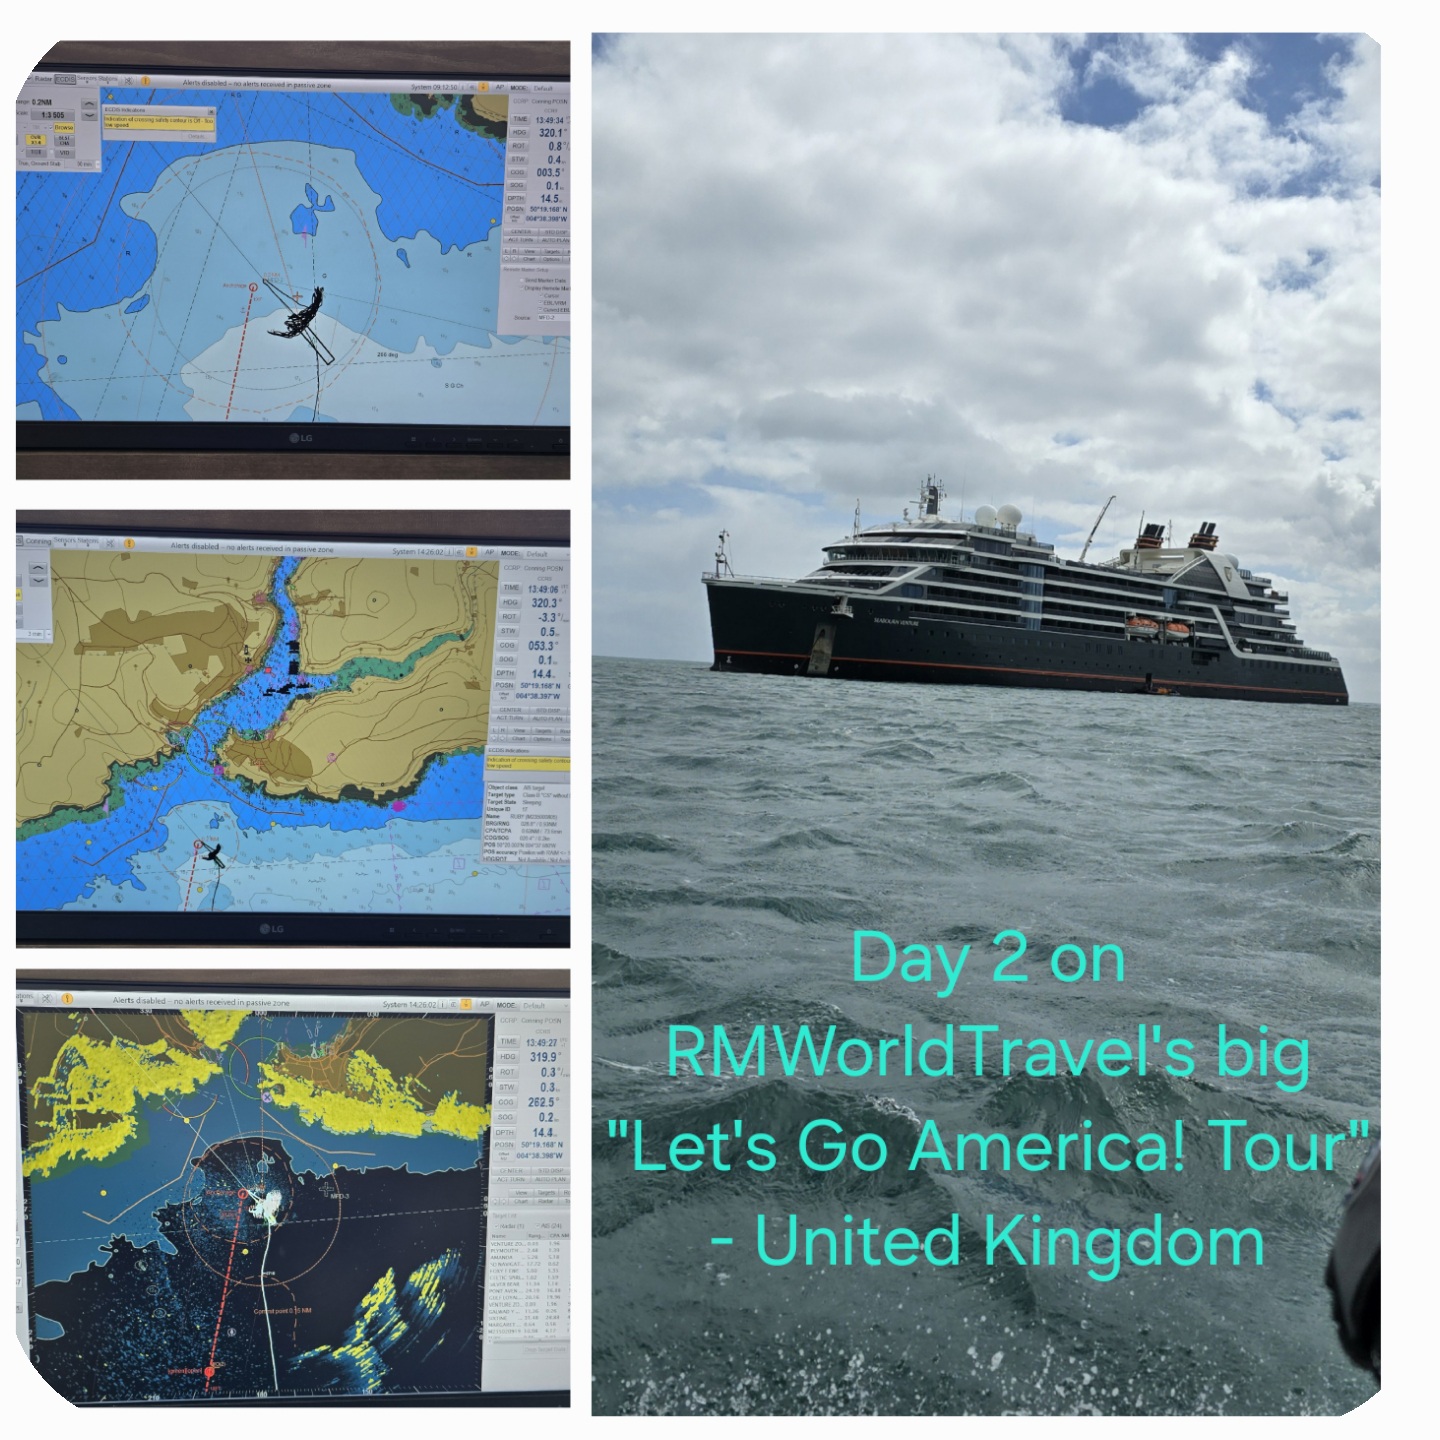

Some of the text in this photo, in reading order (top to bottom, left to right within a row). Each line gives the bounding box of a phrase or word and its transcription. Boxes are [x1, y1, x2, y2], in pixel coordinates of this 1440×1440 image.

[539, 128, 562, 137] 320.1
[549, 142, 562, 151] 0.8
[548, 155, 561, 164] 0.4
[537, 168, 560, 177] 003.5
[546, 181, 559, 190] 0.1
[541, 194, 559, 203] 14.5
[191, 542, 219, 550] disabled
[292, 545, 317, 553] passive
[392, 547, 444, 556] System 14:26:02
[528, 585, 558, 593] 13:49:06
[532, 598, 557, 608] 320.3
[538, 613, 556, 622] -3.3
[540, 627, 555, 637] 0.5
[528, 641, 554, 651] 053.3
[538, 655, 552, 665] 0.1
[532, 669, 551, 679] 14.4
[271, 925, 284, 933] LG
[526, 1038, 557, 1047] 13:49:27
[530, 1052, 557, 1062] 319.9
[541, 1067, 556, 1077] 0.3
[540, 1082, 555, 1092] 0.3
[528, 1097, 554, 1107] 262.5
[539, 1112, 553, 1122] 0.2
[533, 1128, 553, 1137] 14.4
